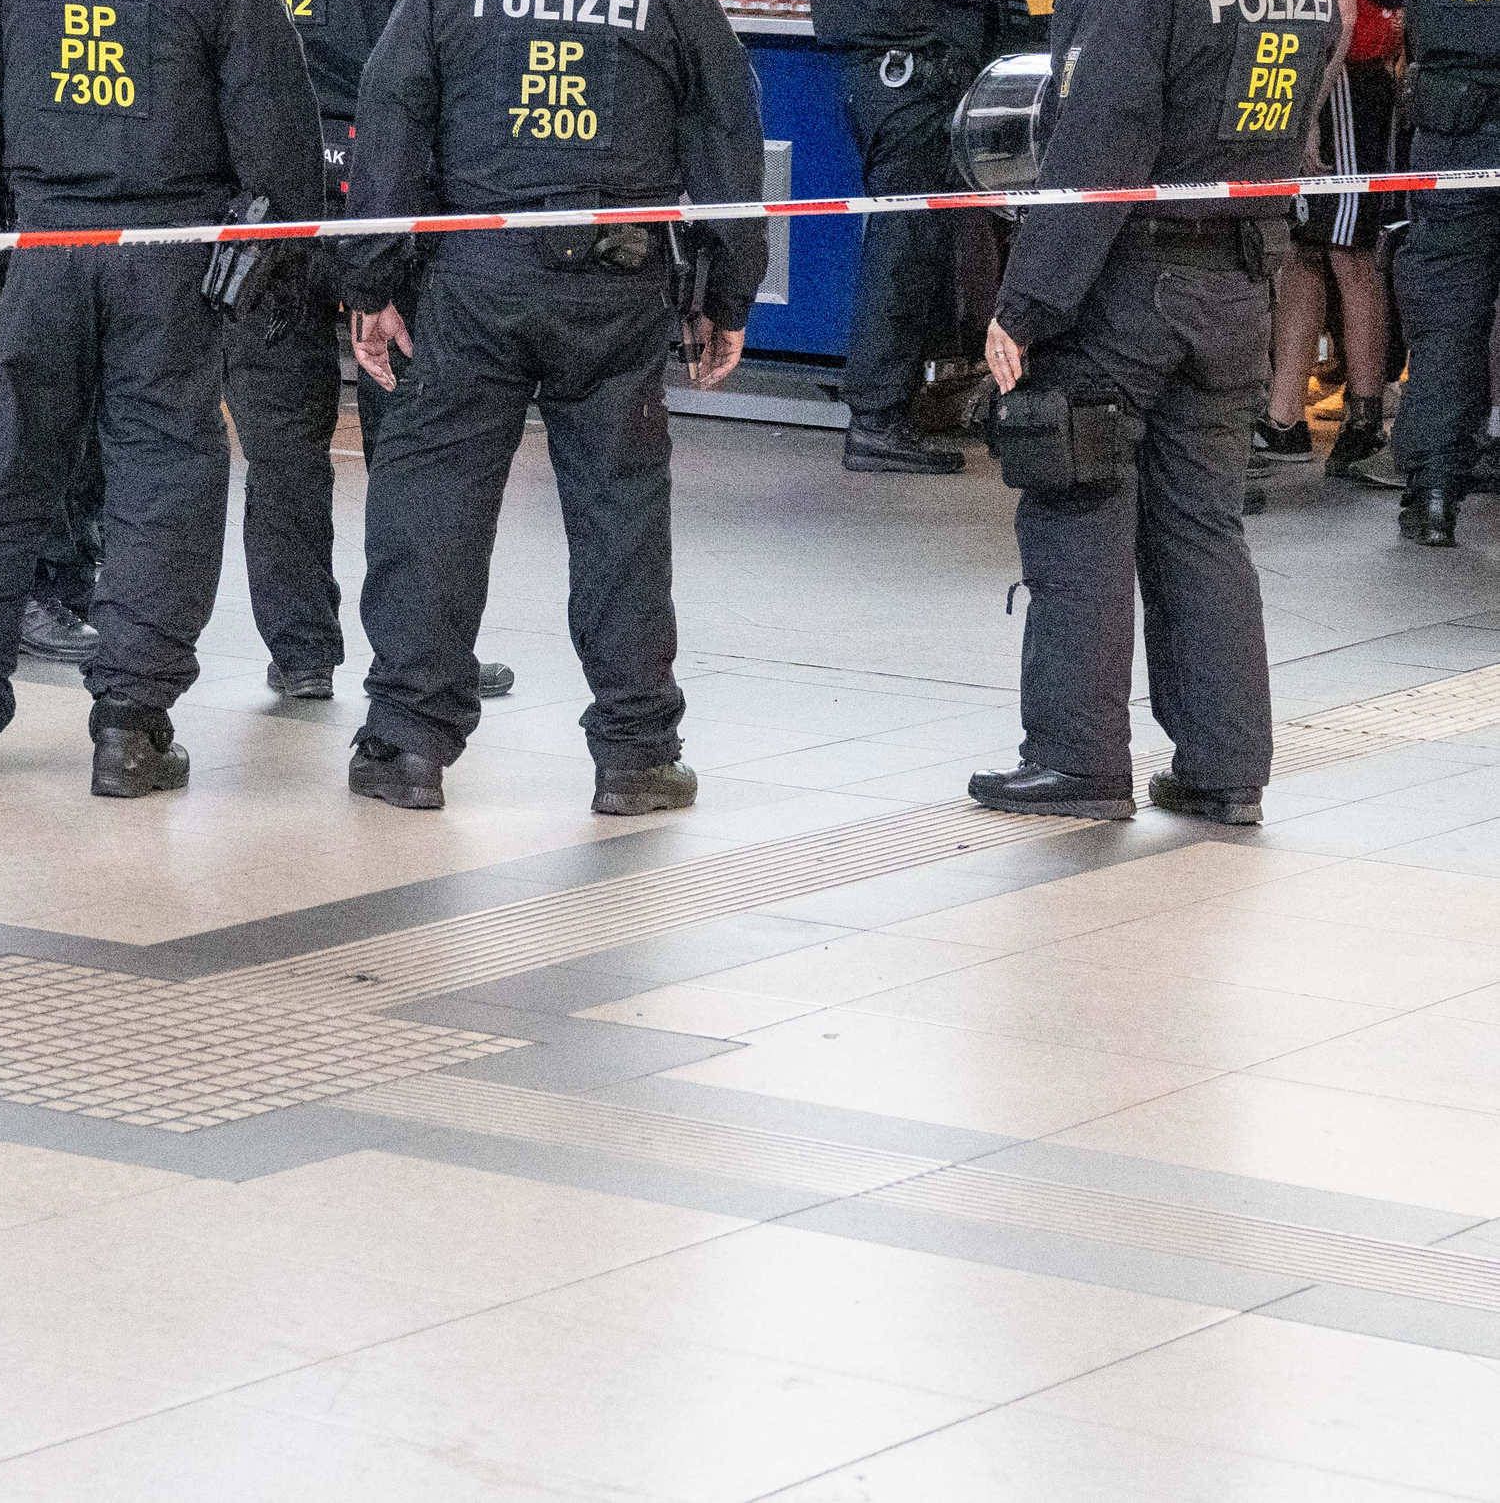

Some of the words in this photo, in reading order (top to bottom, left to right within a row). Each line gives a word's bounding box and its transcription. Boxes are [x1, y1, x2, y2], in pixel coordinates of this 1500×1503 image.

[64, 3, 116, 37] BP
[61, 38, 126, 73] PIR
[529, 40, 585, 72] BP
[1256, 32, 1299, 64] BP
[51, 72, 135, 107] 7300
[521, 74, 587, 106] PIR
[1248, 67, 1297, 99] PIR
[509, 107, 597, 140] 7300
[1236, 101, 1293, 132] 7301
